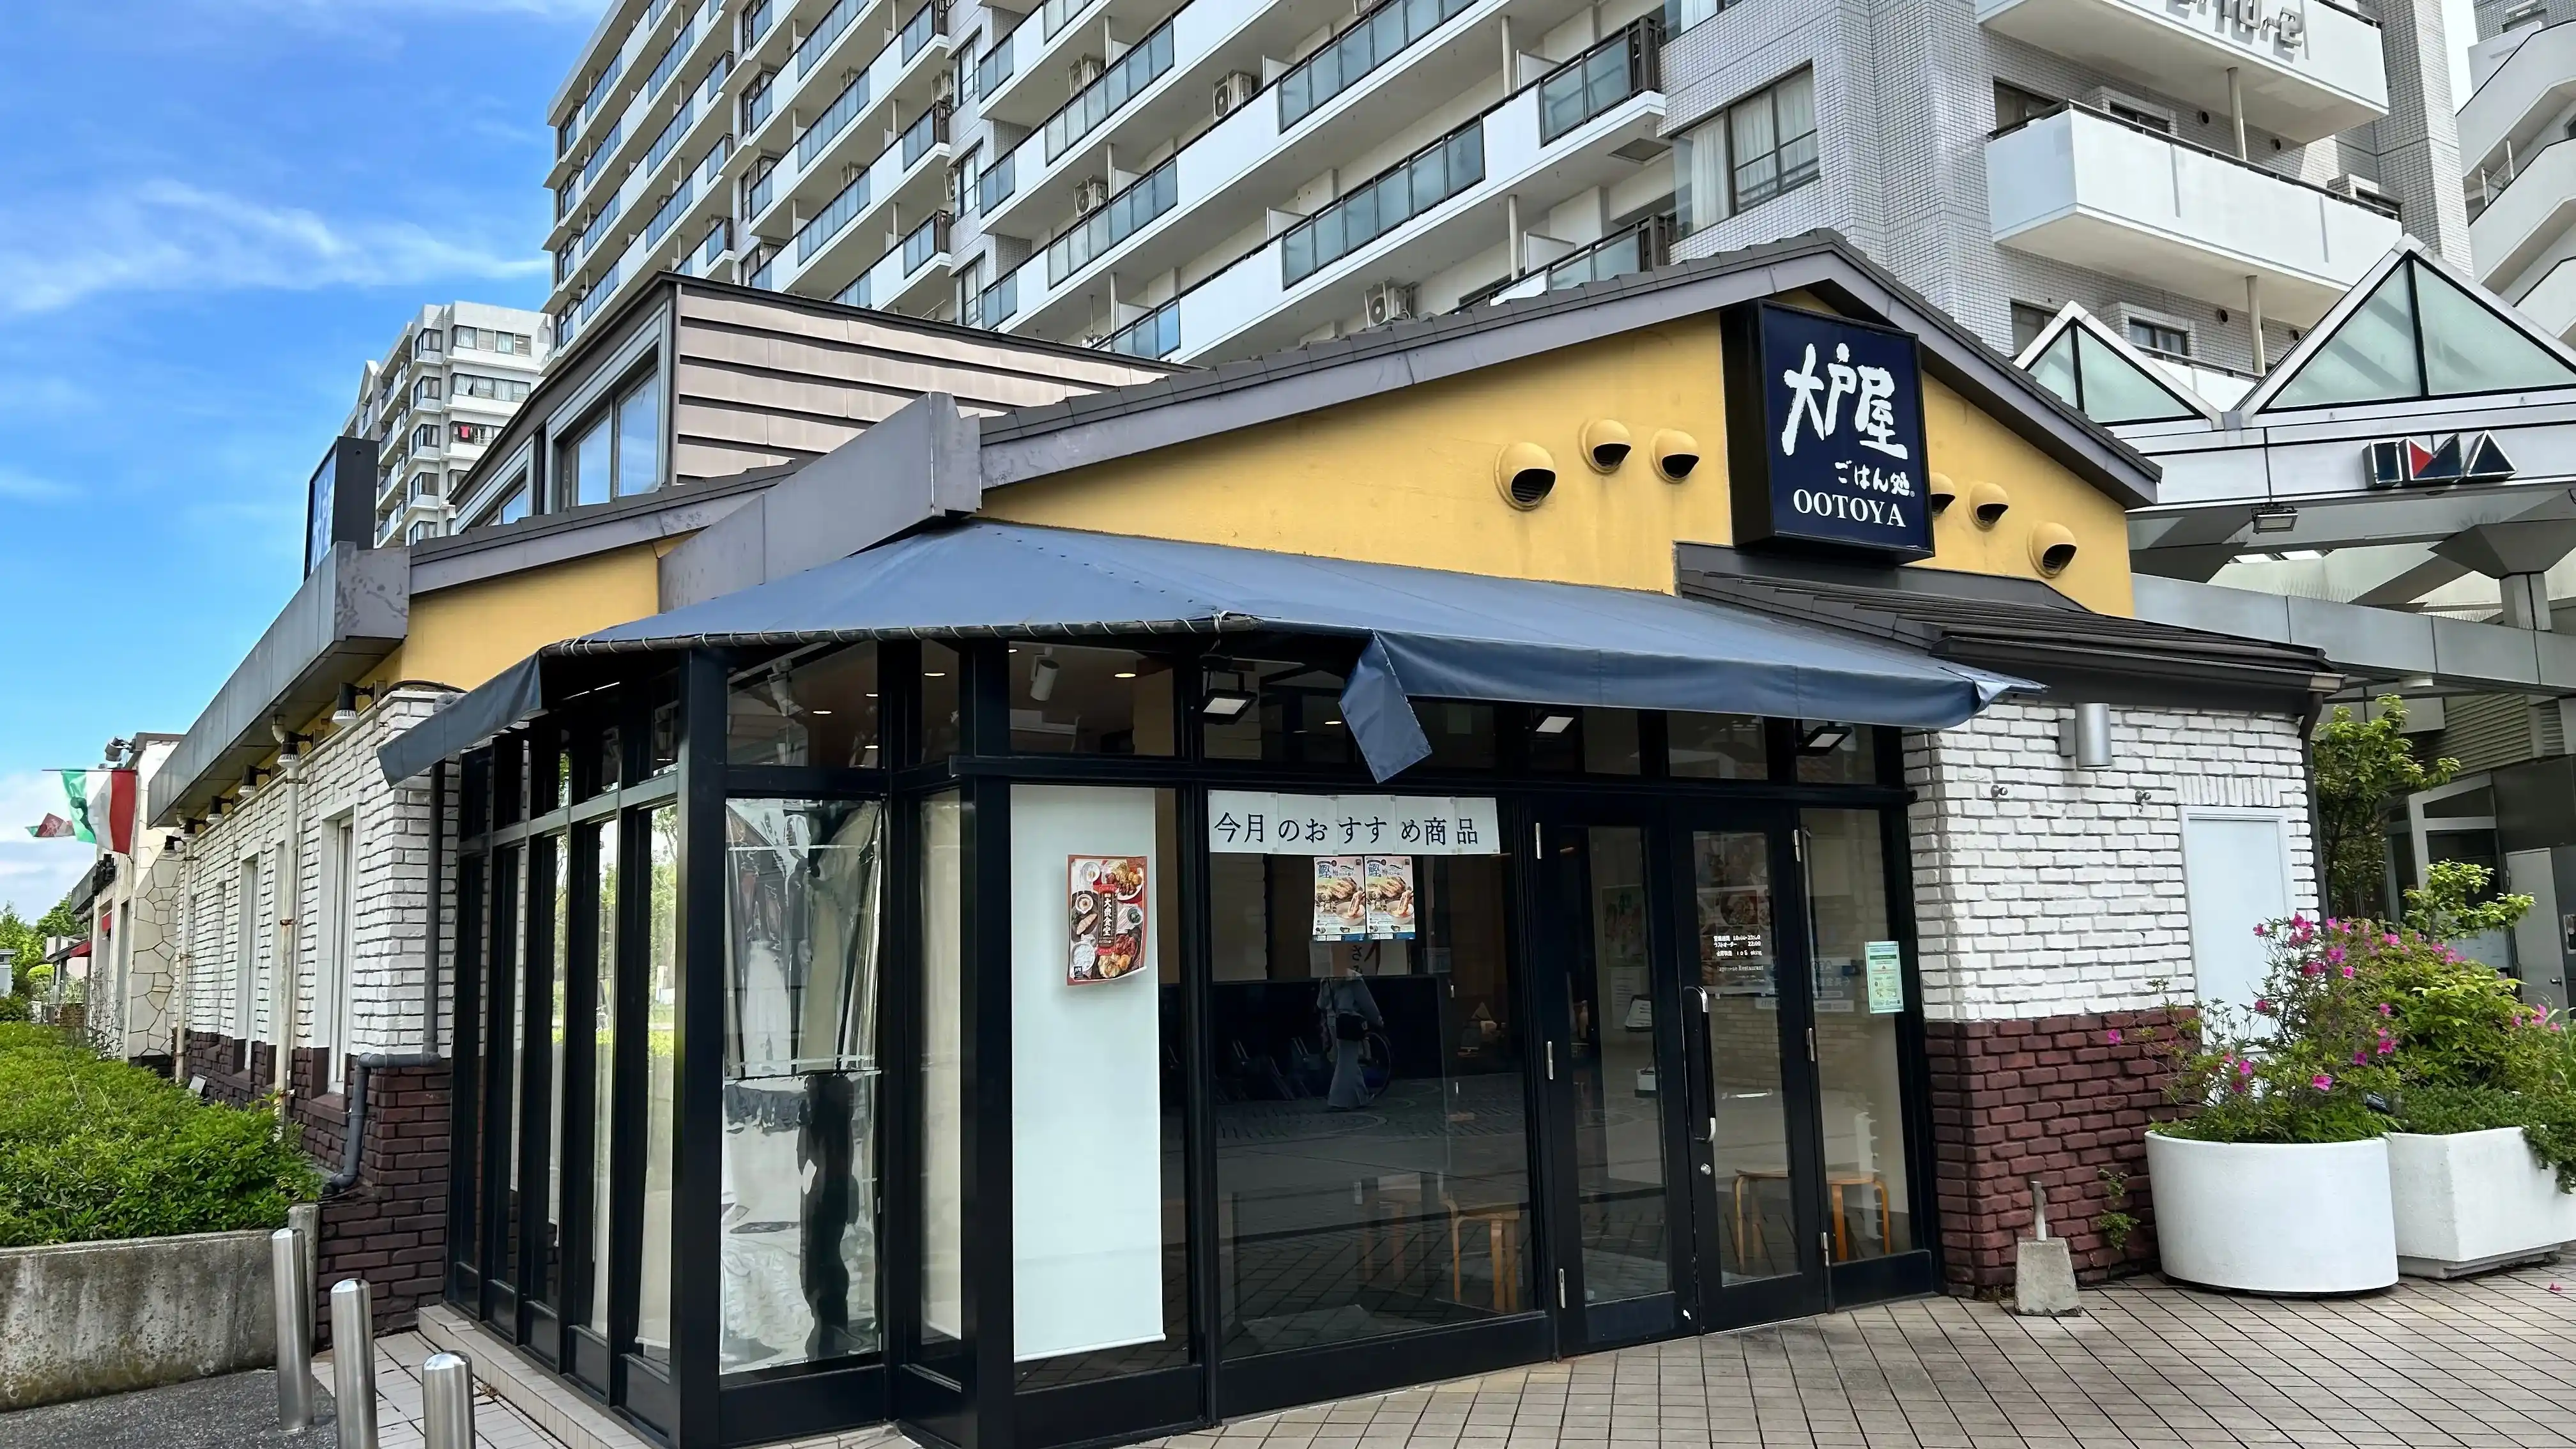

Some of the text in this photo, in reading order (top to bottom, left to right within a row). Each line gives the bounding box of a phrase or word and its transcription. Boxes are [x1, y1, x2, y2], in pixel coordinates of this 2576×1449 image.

[1782, 343, 1908, 459] 大戸屋
[1835, 461, 1910, 496] ごはん処
[1793, 489, 1906, 528] OOTOYA
[1214, 811, 1478, 846] 今月のおすすめ商品
